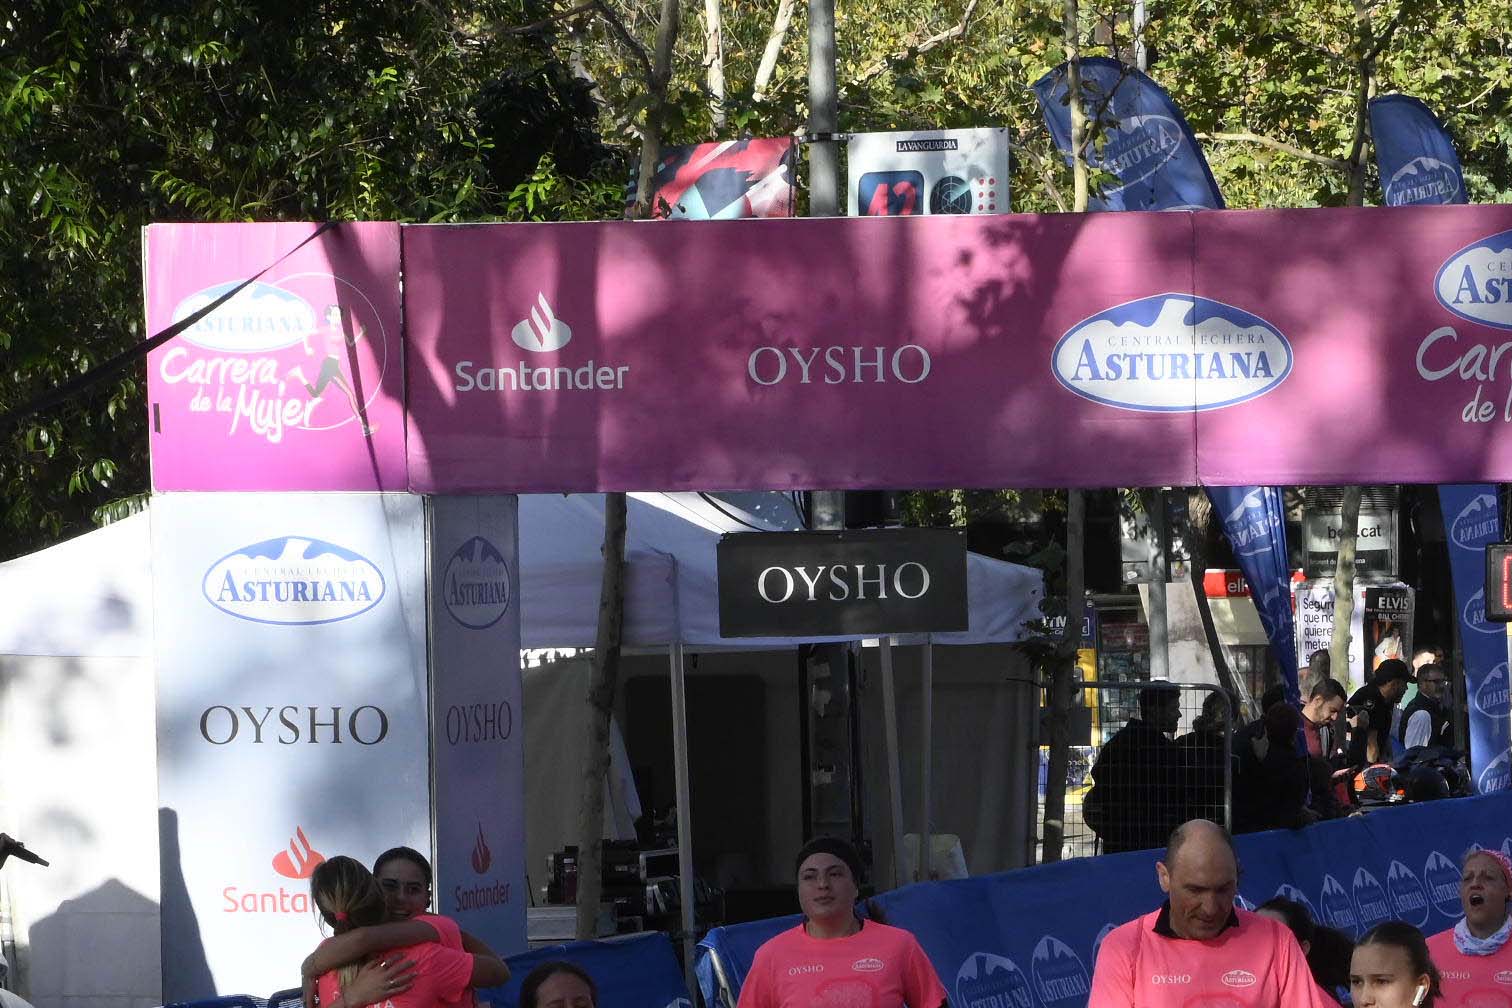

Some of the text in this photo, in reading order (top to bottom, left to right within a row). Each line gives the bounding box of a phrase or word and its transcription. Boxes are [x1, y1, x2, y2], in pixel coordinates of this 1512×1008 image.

[1108, 334, 1182, 347] CENTRAL
[160, 346, 279, 384] Carrera
[455, 360, 630, 392] Santander
[747, 343, 932, 385] OYSHO
[1071, 337, 1274, 382] ASTURIANA
[190, 385, 213, 412] de
[229, 382, 323, 443] Mujer
[1461, 385, 1496, 422] de
[217, 569, 373, 602] ASTURIANA
[757, 562, 931, 604] OYSHO
[1378, 596, 1409, 609] ELVIS
[1303, 614, 1320, 625] que
[199, 704, 390, 746] OYSHO
[446, 700, 513, 747] OYSHO
[223, 886, 313, 914] Santa
[455, 881, 512, 913] Santander
[788, 964, 824, 976] OYSHO
[1151, 974, 1192, 985] OYSHO
